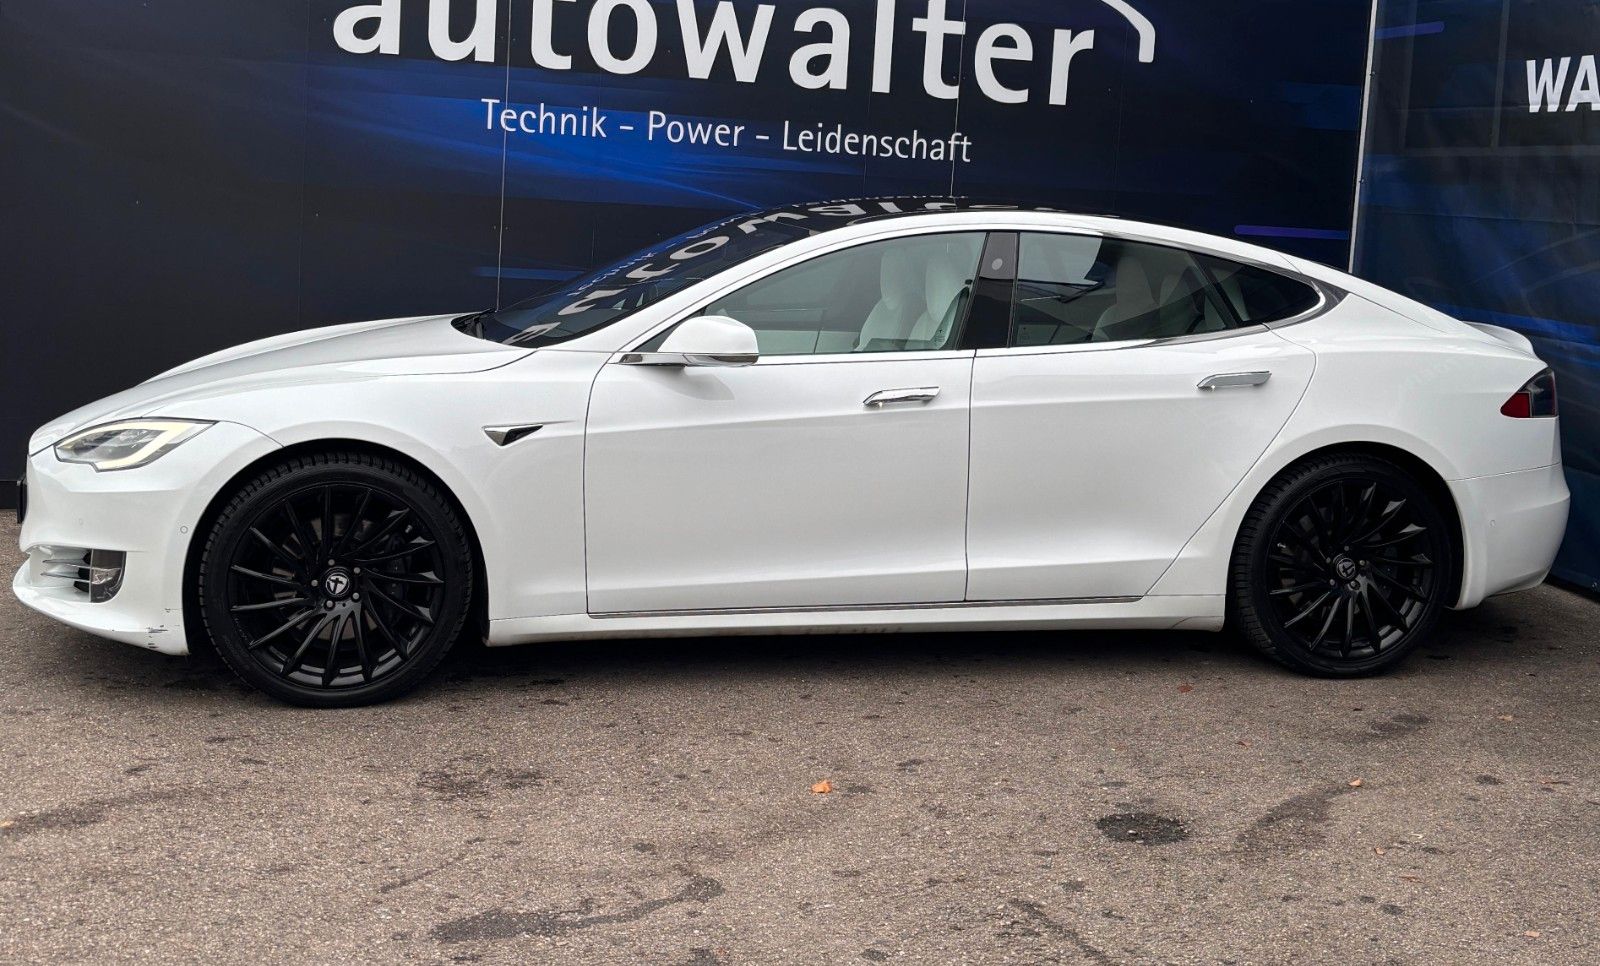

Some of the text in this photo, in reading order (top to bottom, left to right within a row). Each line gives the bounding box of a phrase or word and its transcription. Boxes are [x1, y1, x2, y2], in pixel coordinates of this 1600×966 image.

[332, 0, 1095, 106] autowalter
[481, 98, 607, 138] Technik
[648, 110, 745, 147] Power
[783, 120, 972, 163] Leidenschaft
